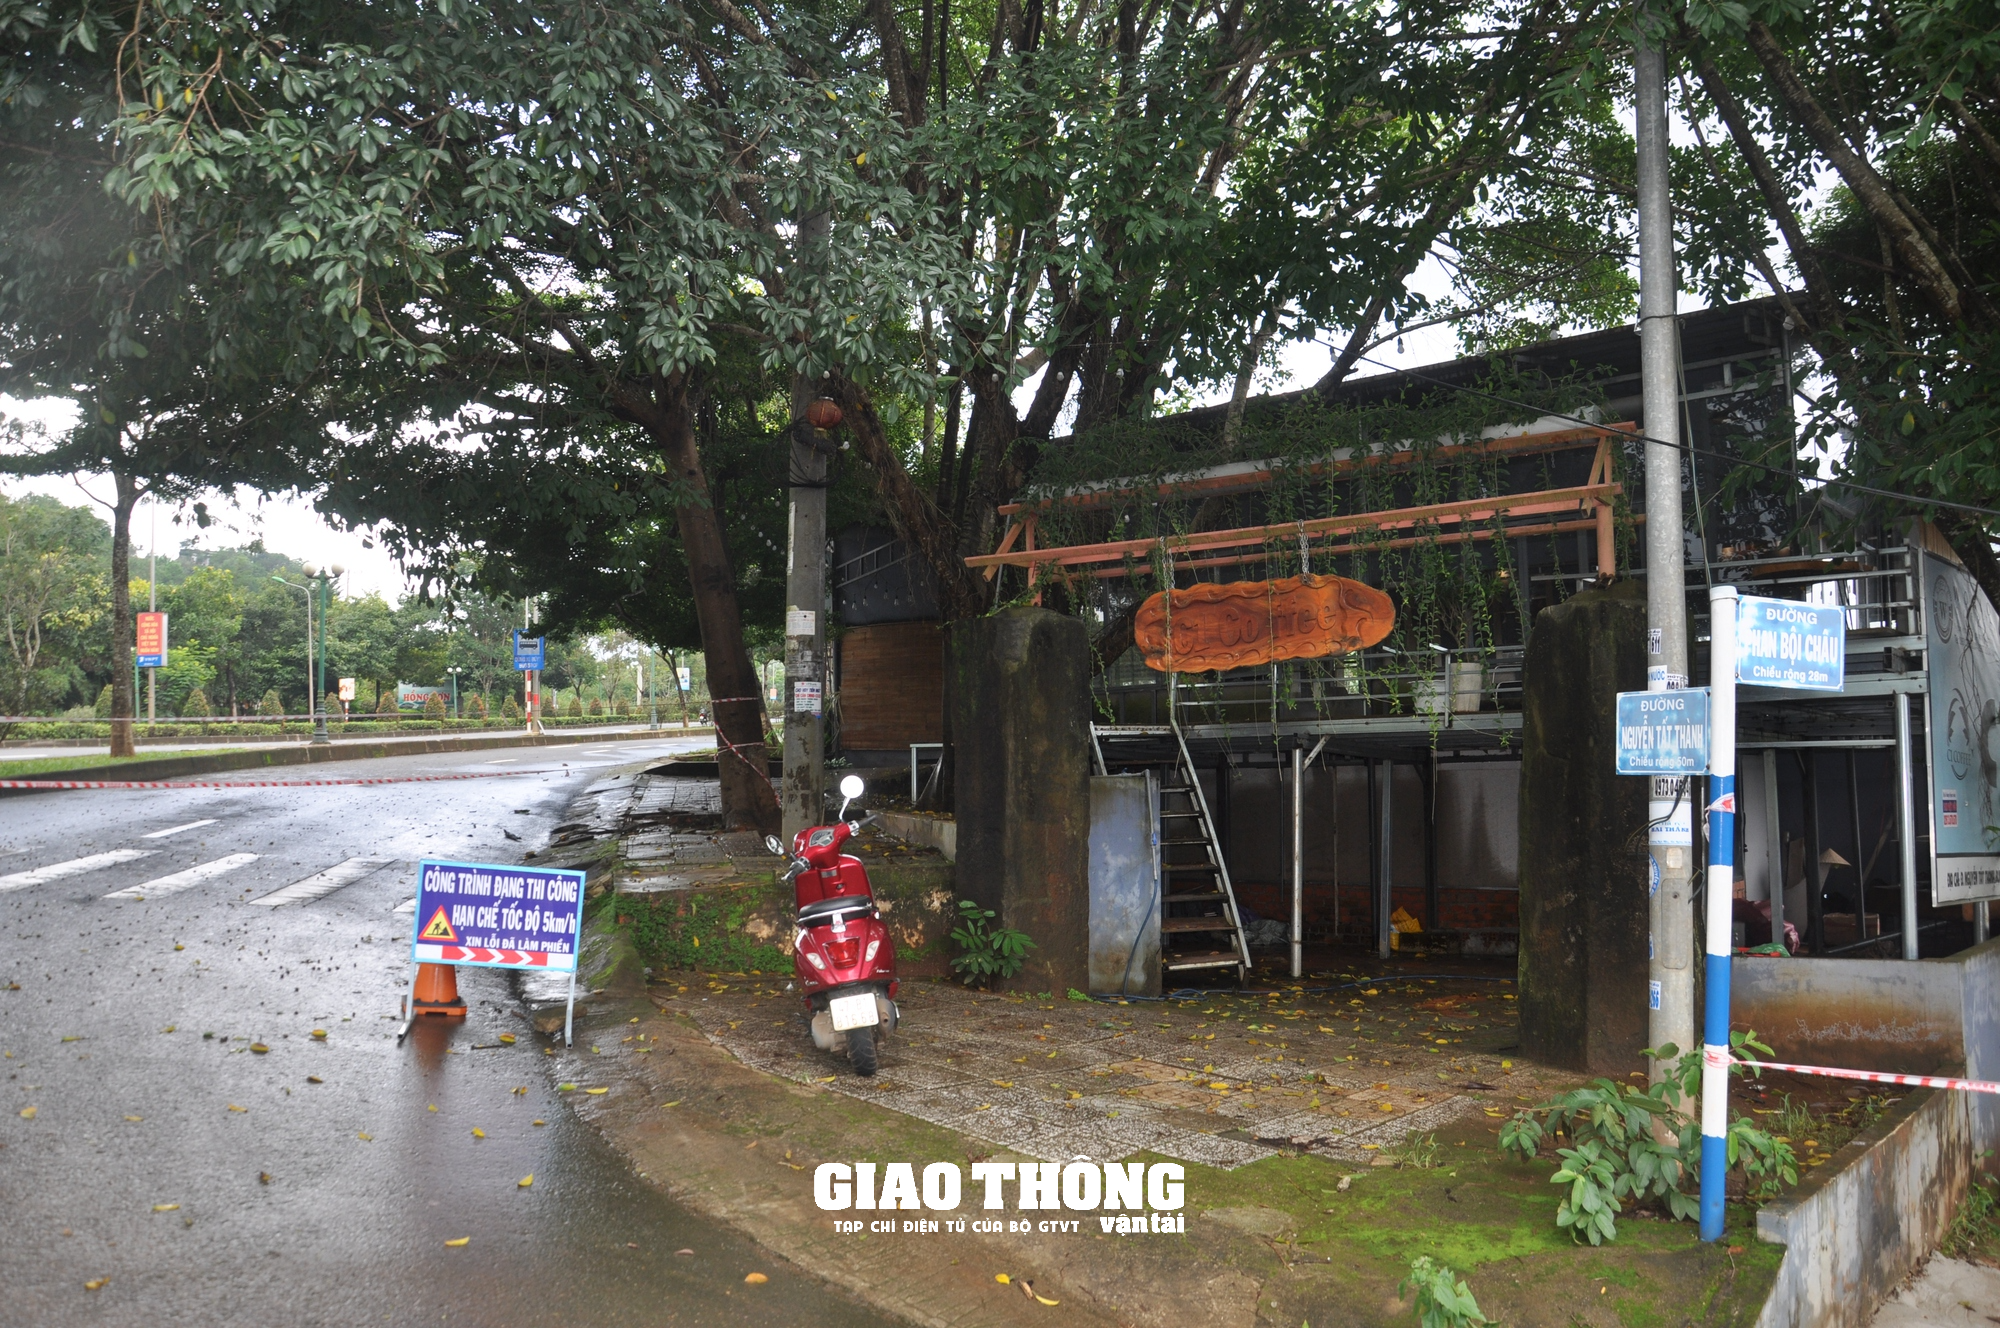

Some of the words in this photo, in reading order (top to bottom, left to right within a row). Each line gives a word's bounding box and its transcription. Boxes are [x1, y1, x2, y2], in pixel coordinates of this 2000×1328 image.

[1766, 607, 1818, 624] ĐƯỜNG
[1781, 626, 1802, 666] BỘI
[1805, 628, 1838, 664] CHÂU
[1784, 668, 1806, 683] rộng
[1808, 670, 1828, 682] 28m
[1640, 698, 1684, 712] ĐƯỜNG
[1622, 715, 1654, 750] NGUYỄN
[1656, 716, 1673, 749] TẤT
[1675, 718, 1704, 749] THÀNH
[1656, 756, 1677, 769] rộng
[1678, 755, 1694, 767] 50m
[424, 866, 456, 894] CÔNG
[458, 869, 492, 896] TRÌNH
[527, 878, 545, 900] THI
[547, 875, 578, 903] CÔNG
[452, 904, 475, 931] HẠN
[502, 900, 523, 930] TỐC
[524, 905, 540, 936] ĐỘ
[542, 911, 576, 934] 5km/h
[465, 936, 481, 948] XIN
[484, 933, 500, 949] LỖI
[502, 937, 515, 950] ĐÃ
[518, 938, 539, 952] LÀM
